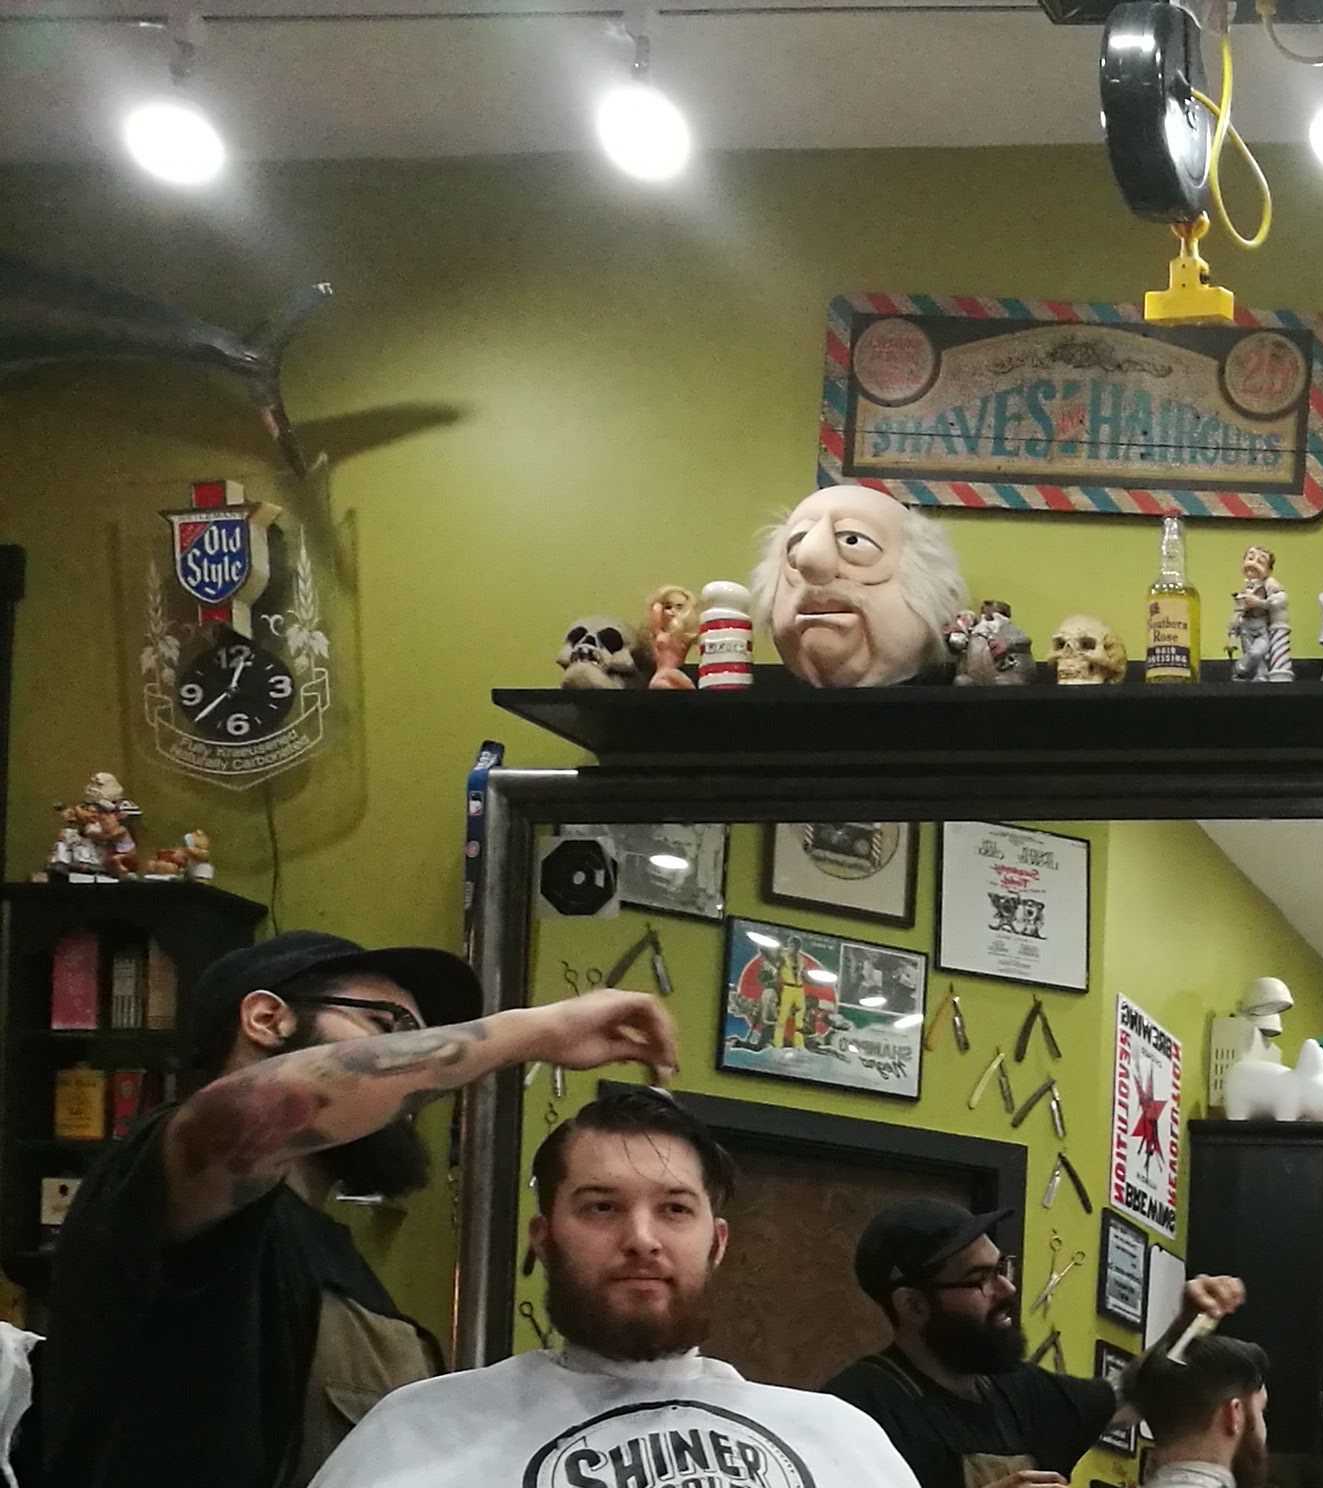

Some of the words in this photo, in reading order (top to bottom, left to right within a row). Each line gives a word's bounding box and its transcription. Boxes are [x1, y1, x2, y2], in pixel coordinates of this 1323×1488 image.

[871, 378, 1057, 458] SHAVES
[203, 525, 241, 556] Old
[186, 549, 243, 590] Style
[216, 646, 251, 669] 12
[180, 683, 204, 706] 9
[269, 675, 293, 699] 3
[226, 713, 250, 736] 6
